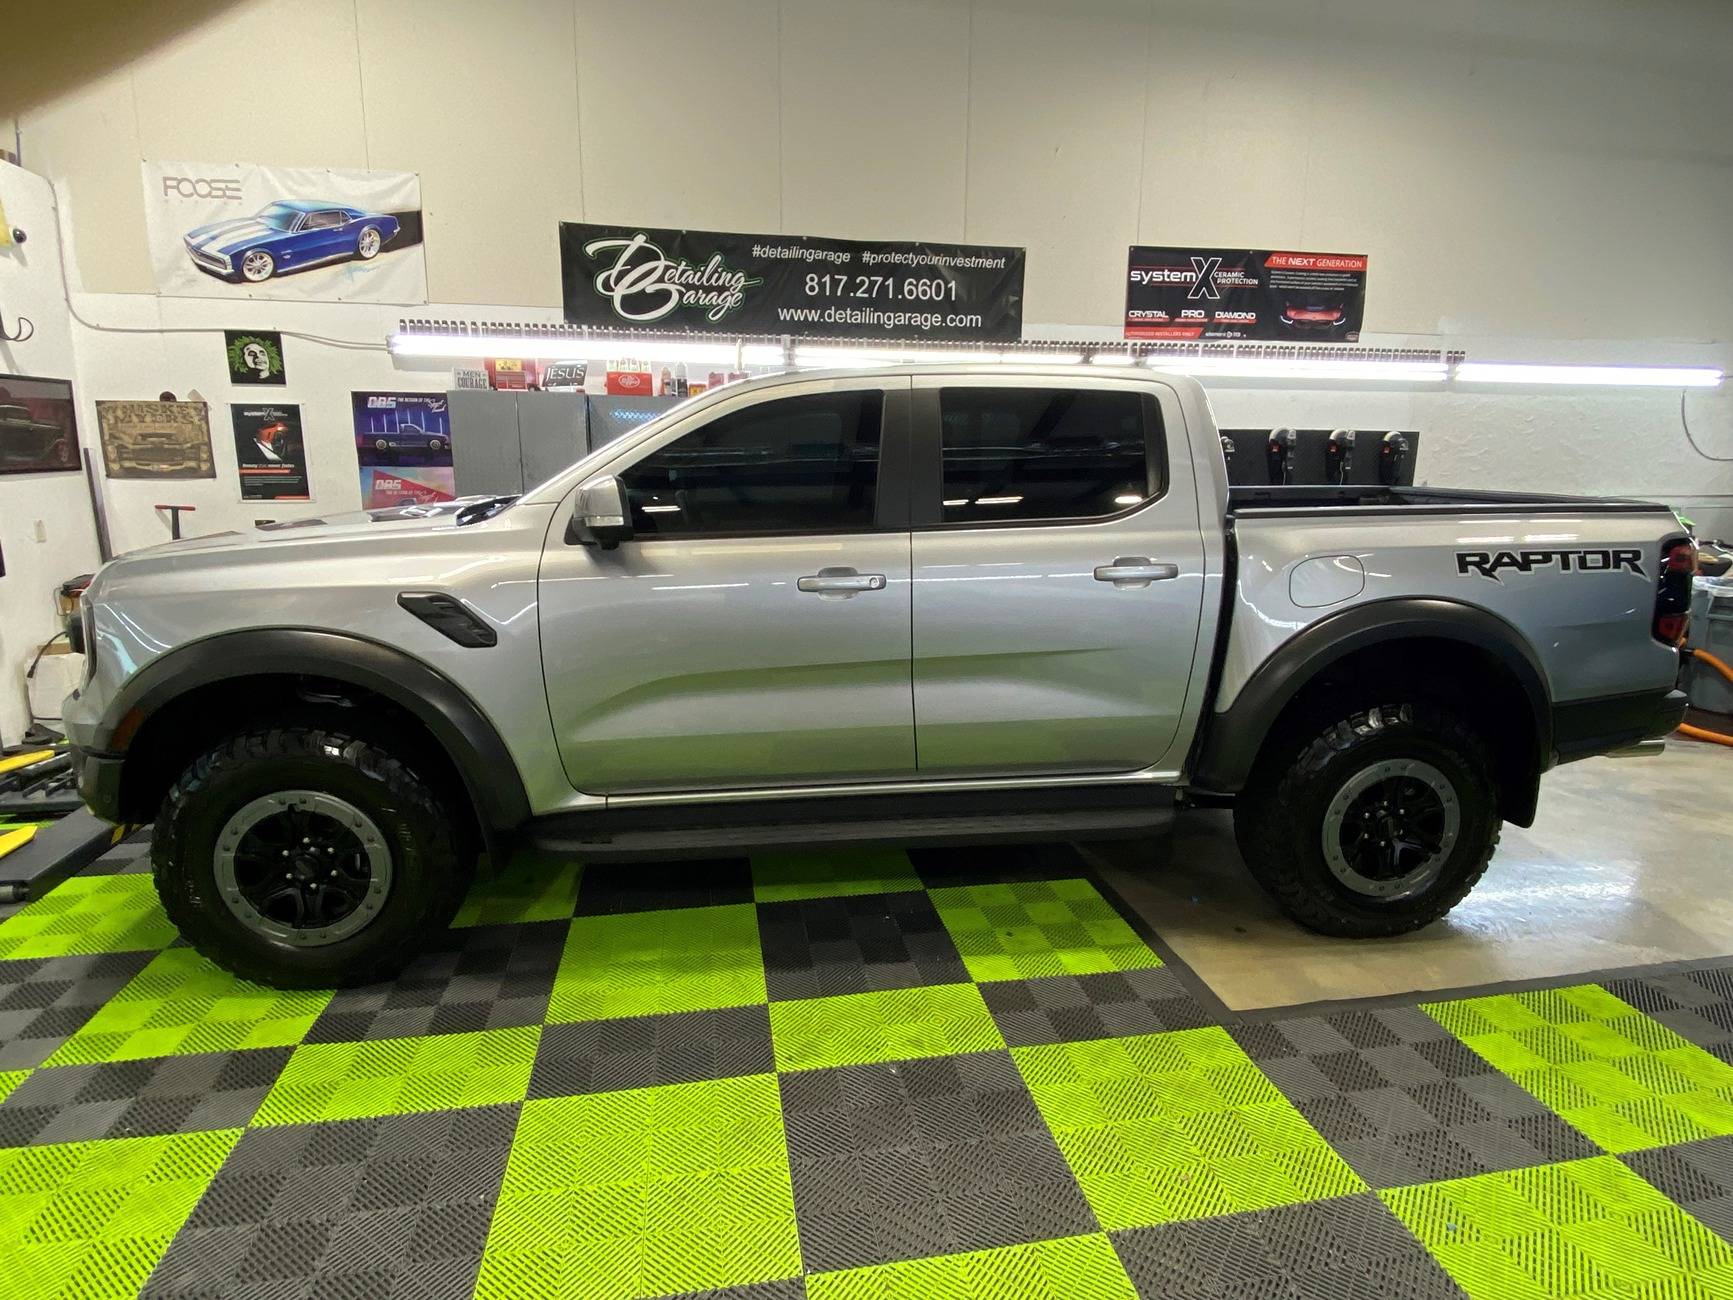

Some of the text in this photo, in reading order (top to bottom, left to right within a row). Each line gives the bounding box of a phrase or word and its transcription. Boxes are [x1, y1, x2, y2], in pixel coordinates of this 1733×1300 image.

[163, 176, 243, 200] FOOSE
[584, 233, 762, 296] Detailing
[752, 243, 1006, 270] #detailingarage #protectyourinvestment
[1271, 256, 1363, 268] THE NEXT GENERATION
[804, 273, 957, 301] 817.271.6601
[1216, 277, 1259, 285] PROTECTION
[613, 260, 744, 321] Garage
[778, 306, 982, 330] www.detailingarage.com
[1128, 310, 1169, 318] CRYSTAL
[1181, 309, 1205, 318] PRO
[1214, 311, 1257, 320] DIAMOND
[462, 370, 481, 379] MEN
[545, 366, 585, 382] JESUS
[457, 377, 488, 389] COURAGE
[1455, 548, 1651, 585] RAPTOR
